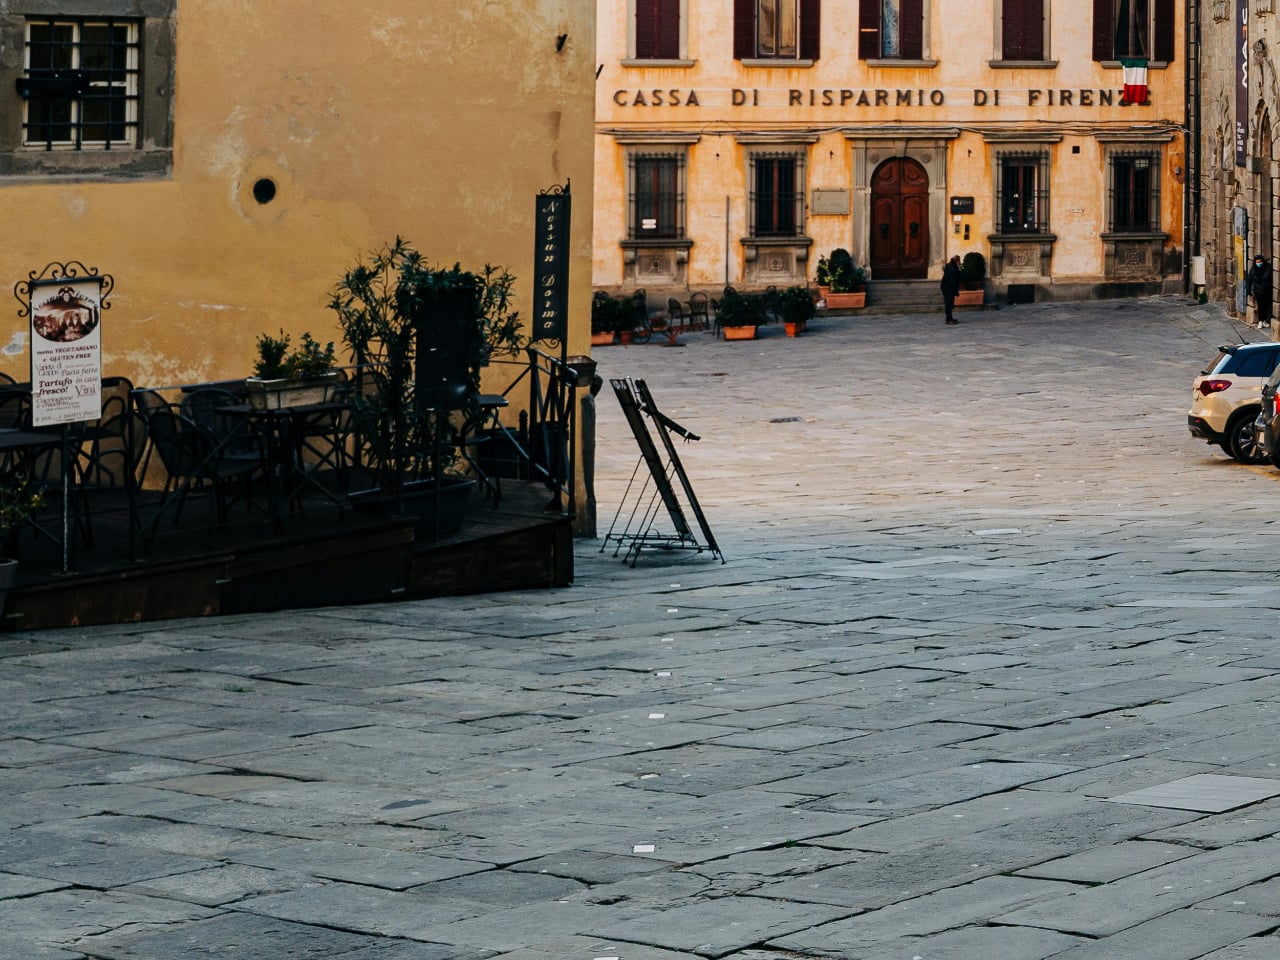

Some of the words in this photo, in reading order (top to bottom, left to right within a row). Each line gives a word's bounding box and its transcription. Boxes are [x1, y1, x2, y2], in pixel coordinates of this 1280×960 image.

[613, 88, 701, 107] CASSA
[732, 88, 758, 107] DI
[788, 88, 945, 107] RISPARMIO
[973, 88, 999, 107] DI
[542, 200, 560, 263] Nessun
[541, 273, 558, 329] Dorma
[36, 385, 69, 398] fresco!
[38, 377, 73, 388] Tartufo
